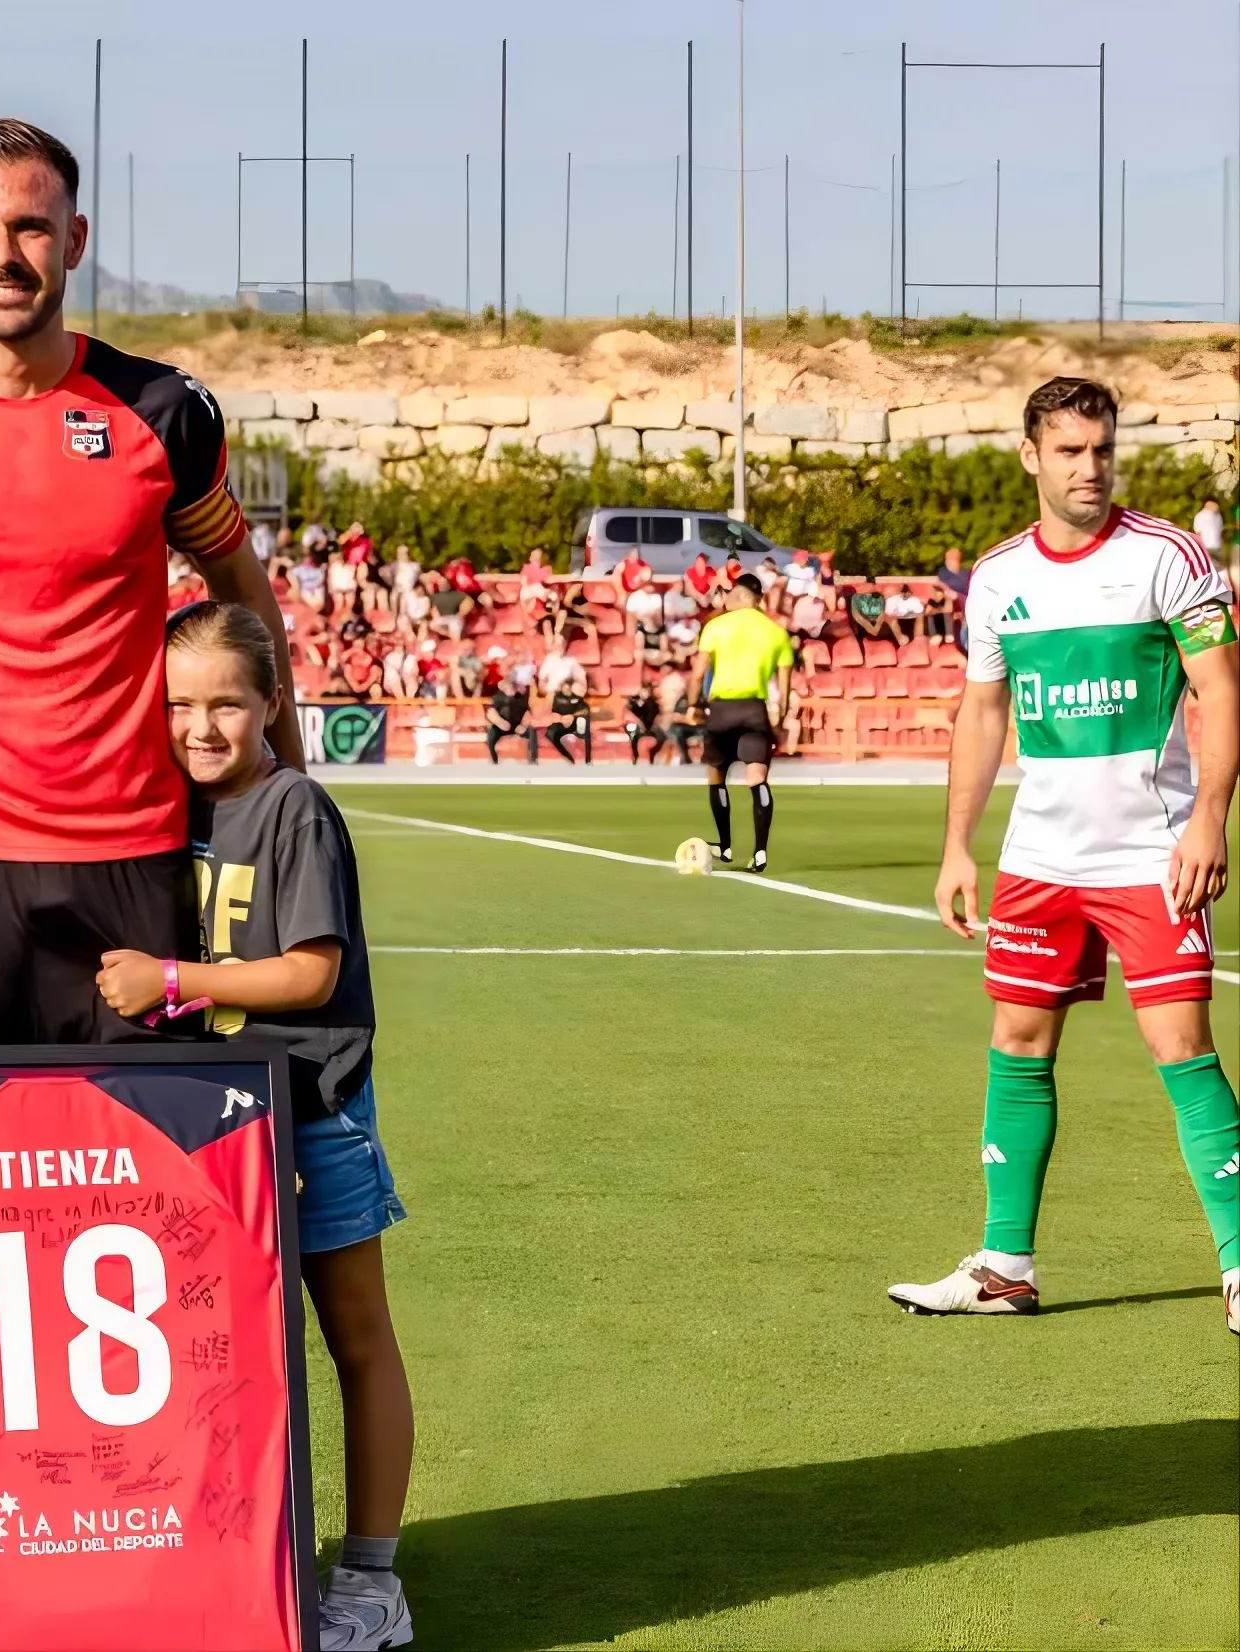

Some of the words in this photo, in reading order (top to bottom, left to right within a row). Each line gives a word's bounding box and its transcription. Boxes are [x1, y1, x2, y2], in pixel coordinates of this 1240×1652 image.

[19, 1511, 53, 1538] LA
[19, 1541, 79, 1556] CIUDAD
[81, 1538, 111, 1552] DEL
[113, 1532, 185, 1552] DEPORTE
